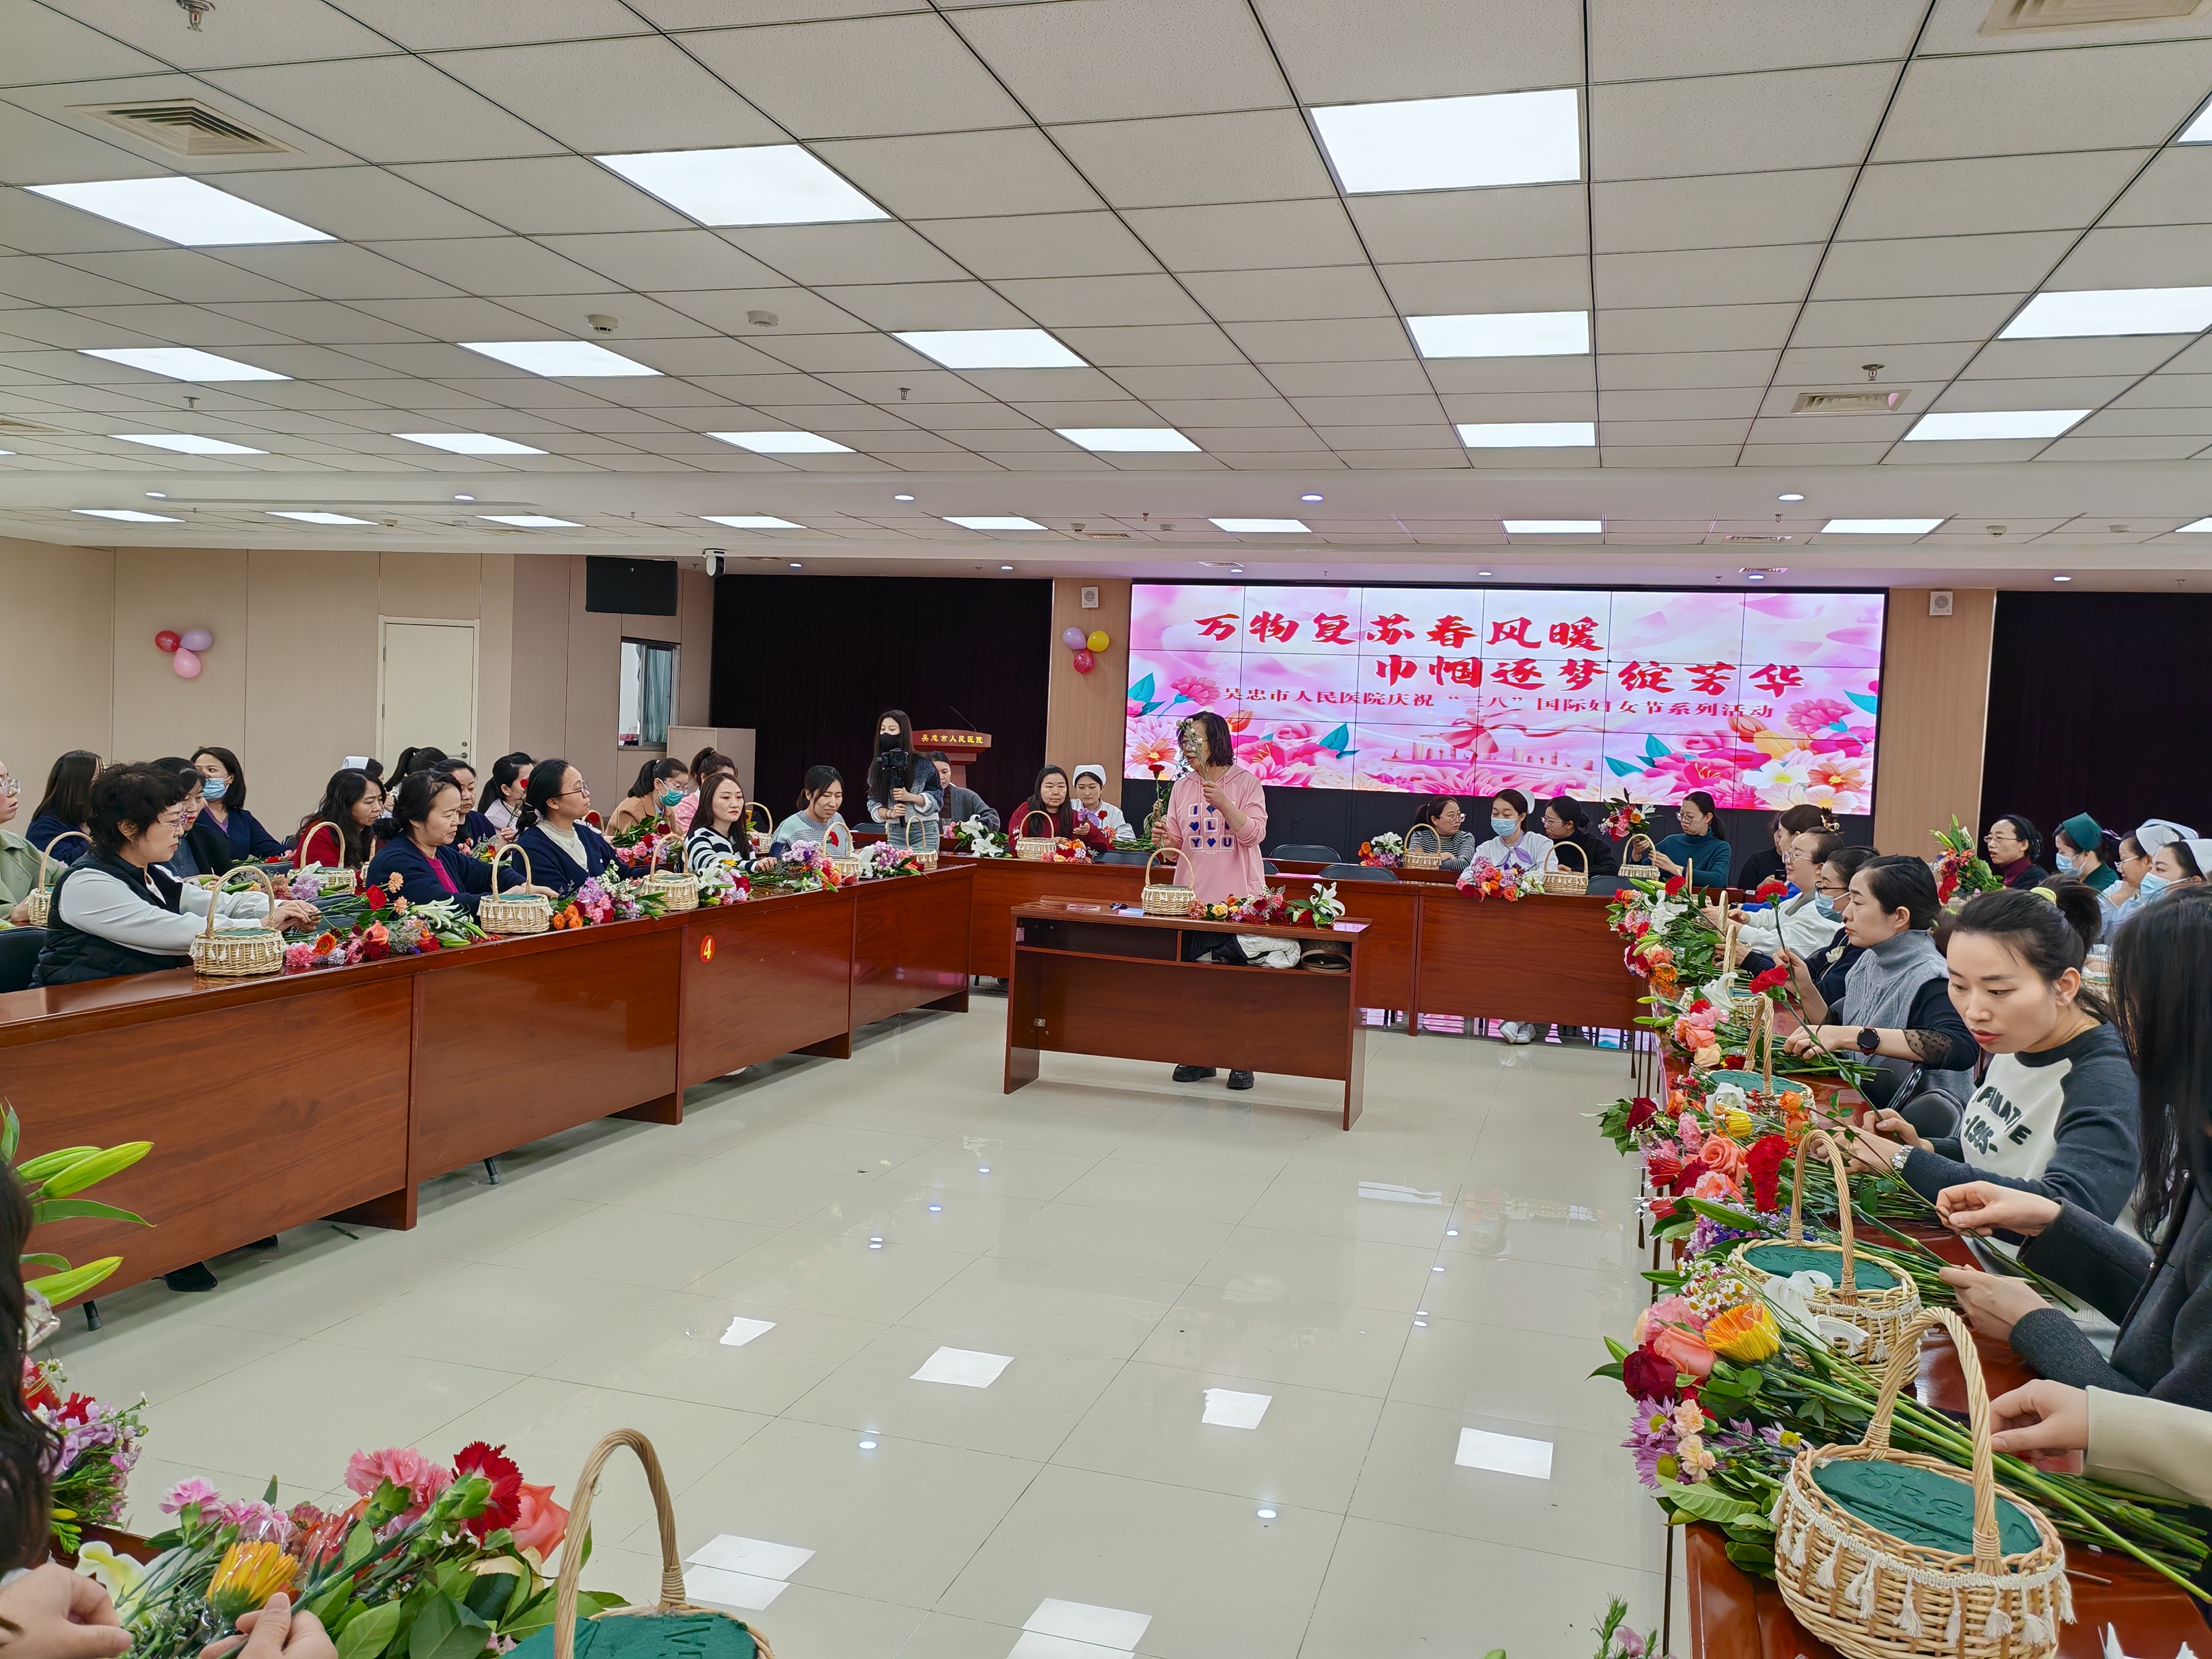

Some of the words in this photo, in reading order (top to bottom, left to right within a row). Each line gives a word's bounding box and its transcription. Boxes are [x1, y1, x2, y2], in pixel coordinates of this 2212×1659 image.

[1193, 611, 1605, 651] 万物复苏春风暖
[1376, 655, 1804, 698] 巾帼逐梦绽芳华
[921, 734, 983, 744] 吴忠市人民医院
[703, 938, 712, 959] 4
